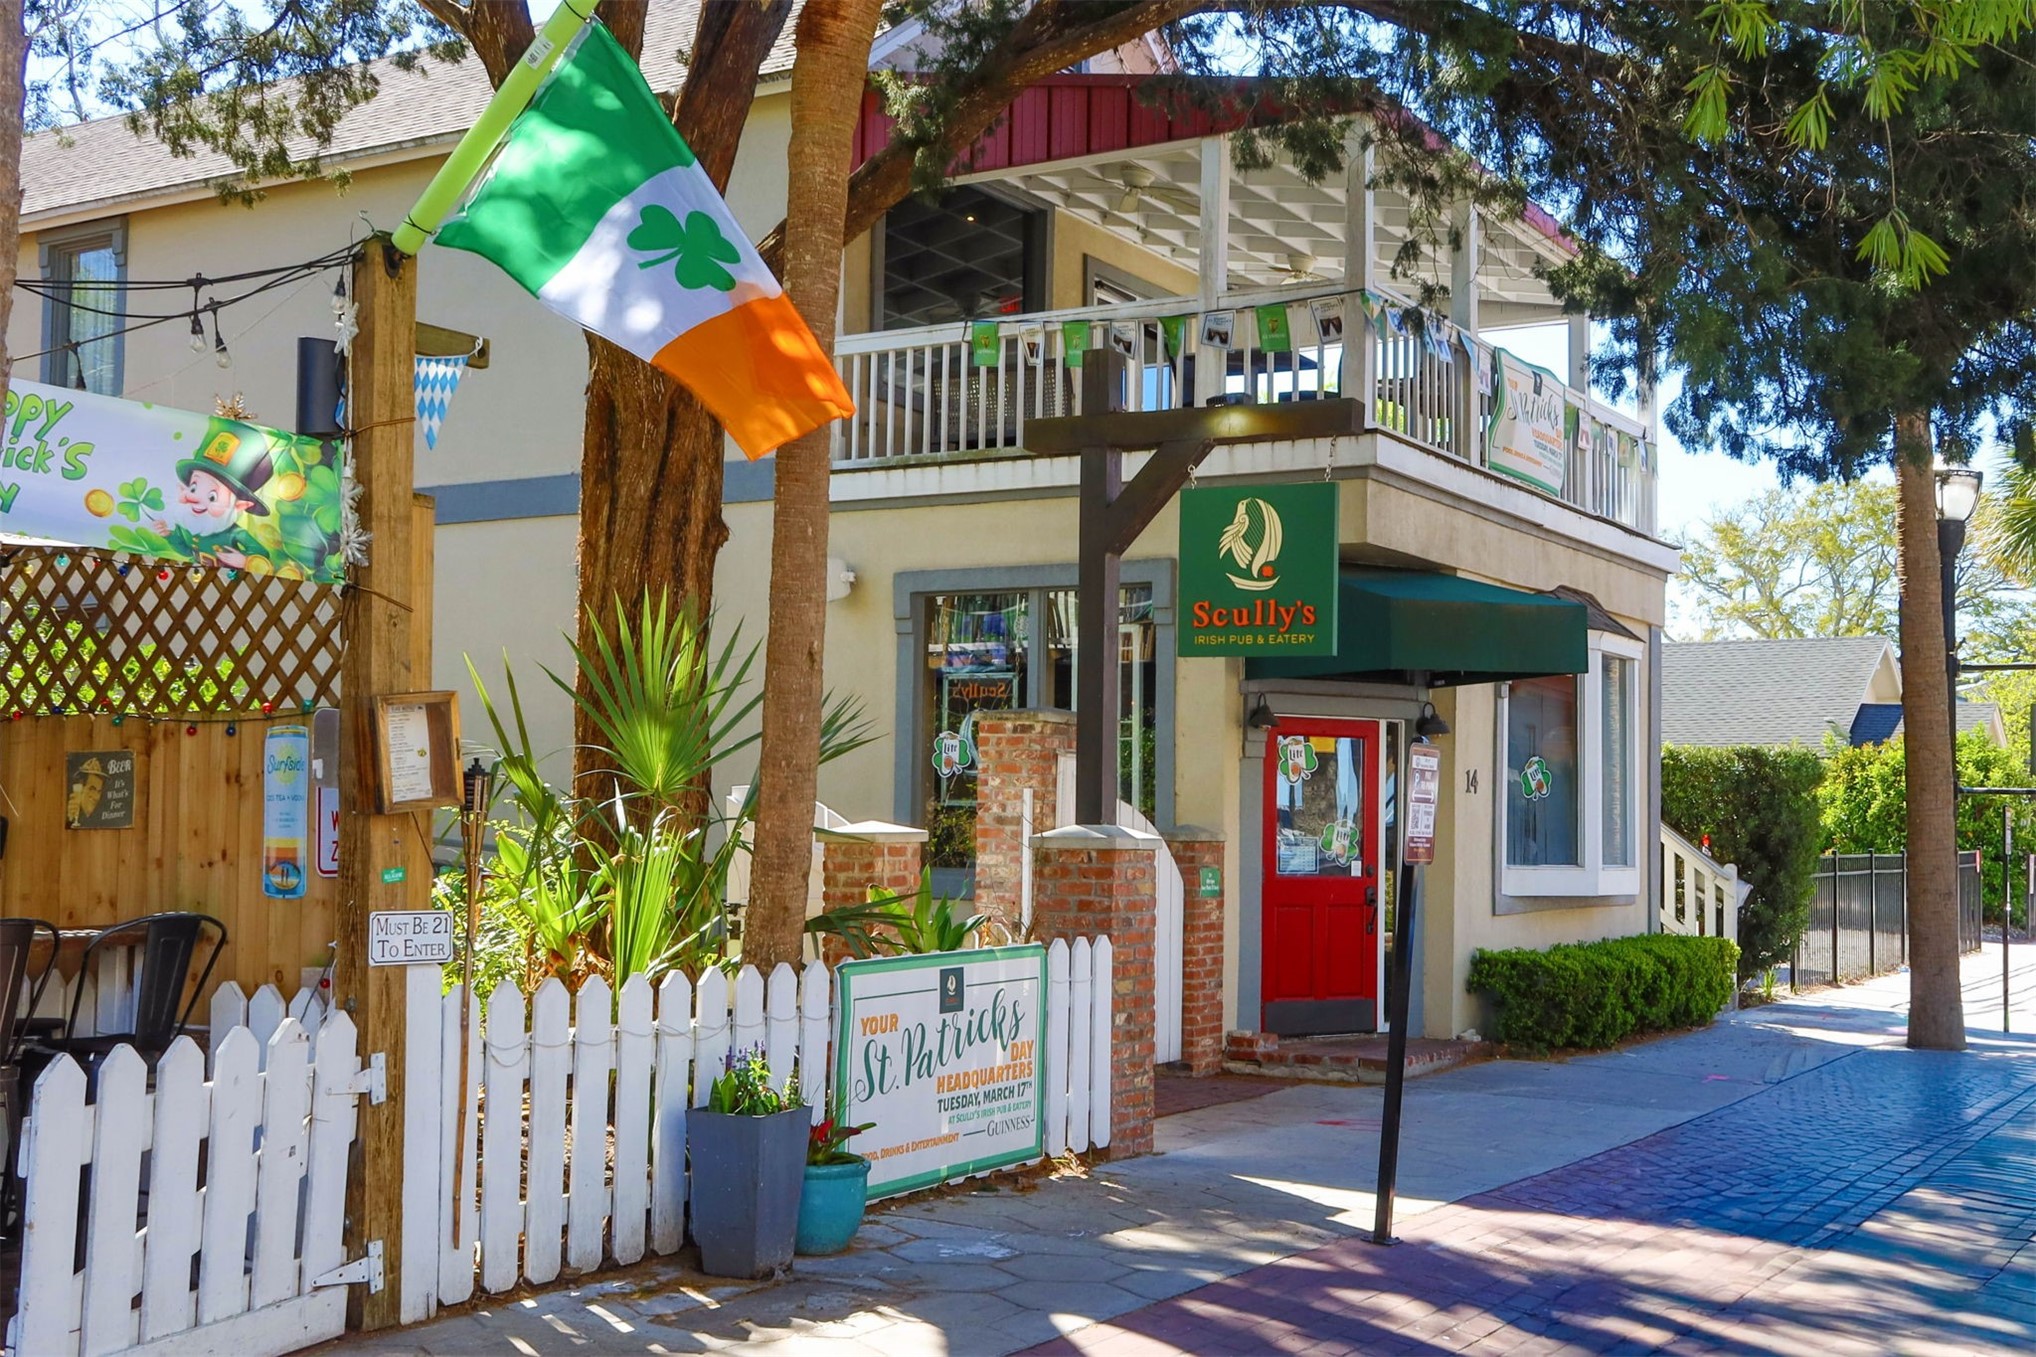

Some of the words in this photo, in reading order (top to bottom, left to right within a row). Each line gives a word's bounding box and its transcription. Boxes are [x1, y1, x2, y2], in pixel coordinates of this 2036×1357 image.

[1192, 598, 1316, 633] Scully's
[1194, 635, 1225, 645] IRISH
[1229, 635, 1253, 645] PUB
[1256, 634, 1265, 644] &
[1268, 634, 1315, 644] EATERY
[1465, 769, 1478, 795] 14
[107, 789, 129, 799] What's
[110, 800, 123, 810] For
[101, 810, 125, 820] Dinner
[432, 916, 448, 934] 21
[860, 1013, 898, 1036] YOUR
[853, 1039, 899, 1102] St.
[901, 988, 1025, 1086] Patricks
[1010, 1039, 1034, 1062] DAY
[936, 1061, 1033, 1094] HEADQUARTERS
[937, 1091, 981, 1113] TUESDAY,
[983, 1085, 1015, 1104] MARCH
[980, 1107, 995, 1118] IRISH
[996, 1104, 1007, 1114] PUB
[1007, 1103, 1012, 1112] &
[1012, 1099, 1032, 1111] EATERY
[987, 1115, 1031, 1137] GUINNESS
[905, 1143, 910, 1154] &
[911, 1132, 960, 1152] ENTERTAINMENT
